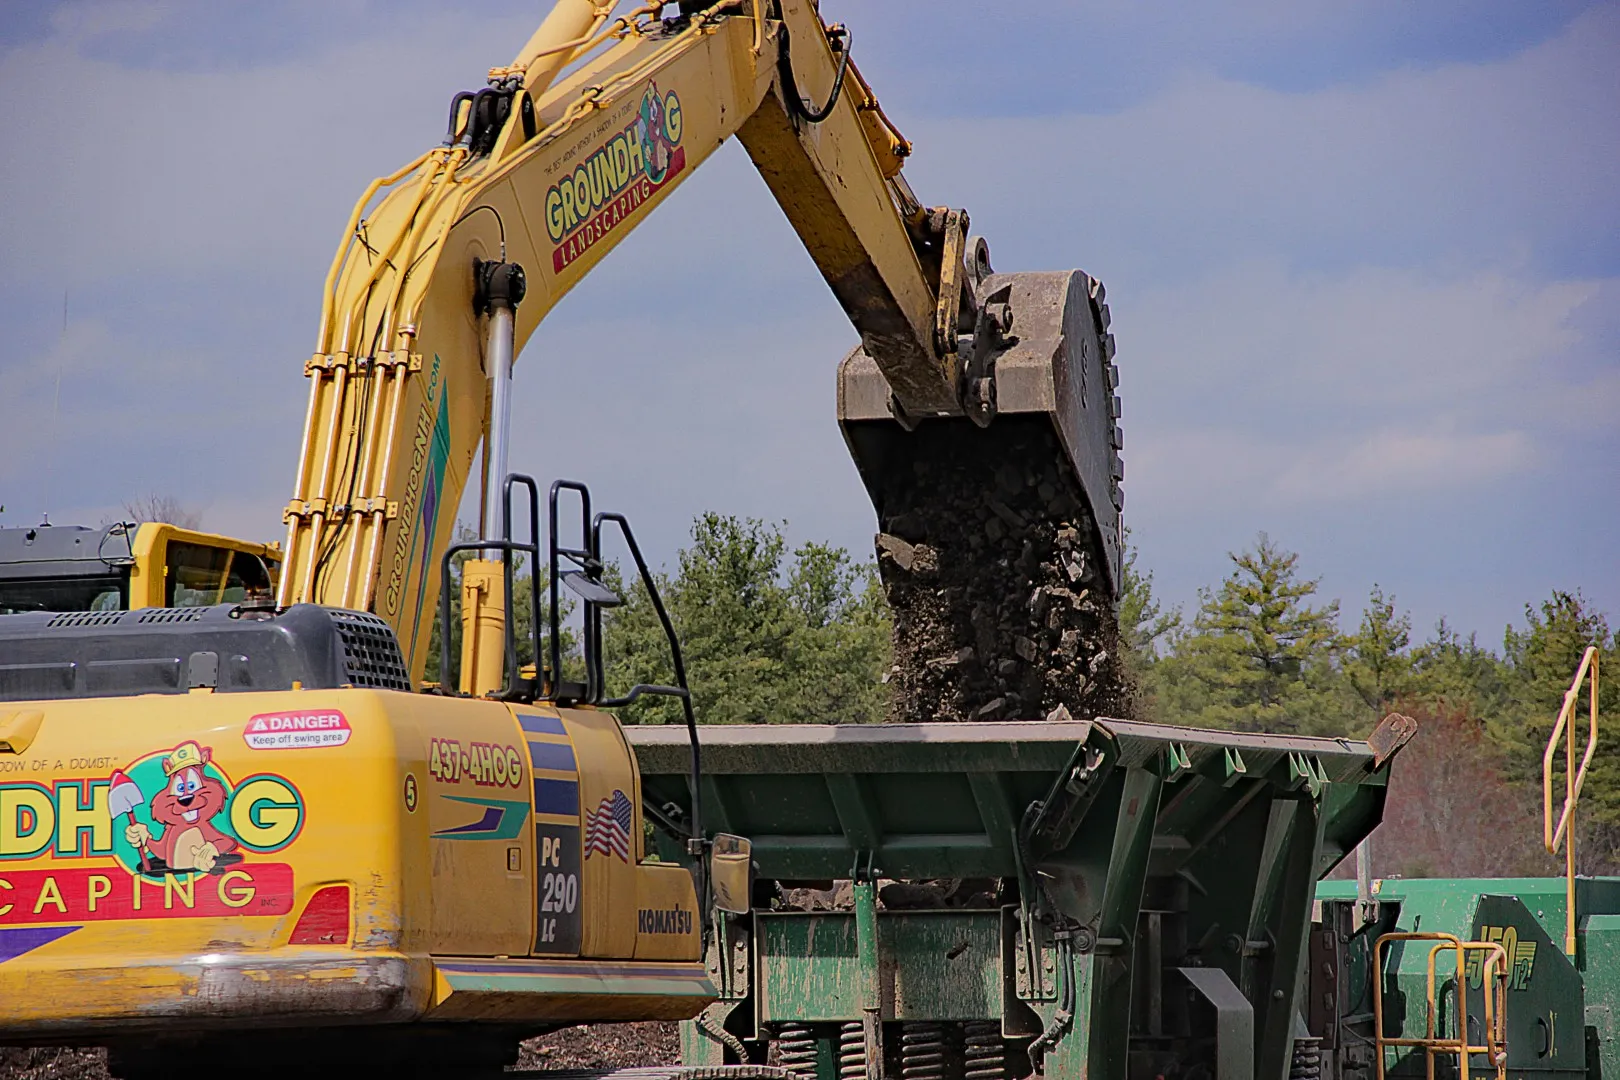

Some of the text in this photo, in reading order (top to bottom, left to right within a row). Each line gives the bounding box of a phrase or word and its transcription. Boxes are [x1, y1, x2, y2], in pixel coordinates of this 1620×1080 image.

[560, 179, 650, 266] LANDSCAPING
[269, 714, 341, 730] DANGER
[253, 733, 343, 745] Keep off swing area
[32, 759, 48, 771] OF
[53, 759, 64, 771] A
[541, 837, 561, 867] PC
[541, 873, 577, 913] 290
[541, 918, 556, 943] LC
[638, 903, 692, 934] KOMATSU
